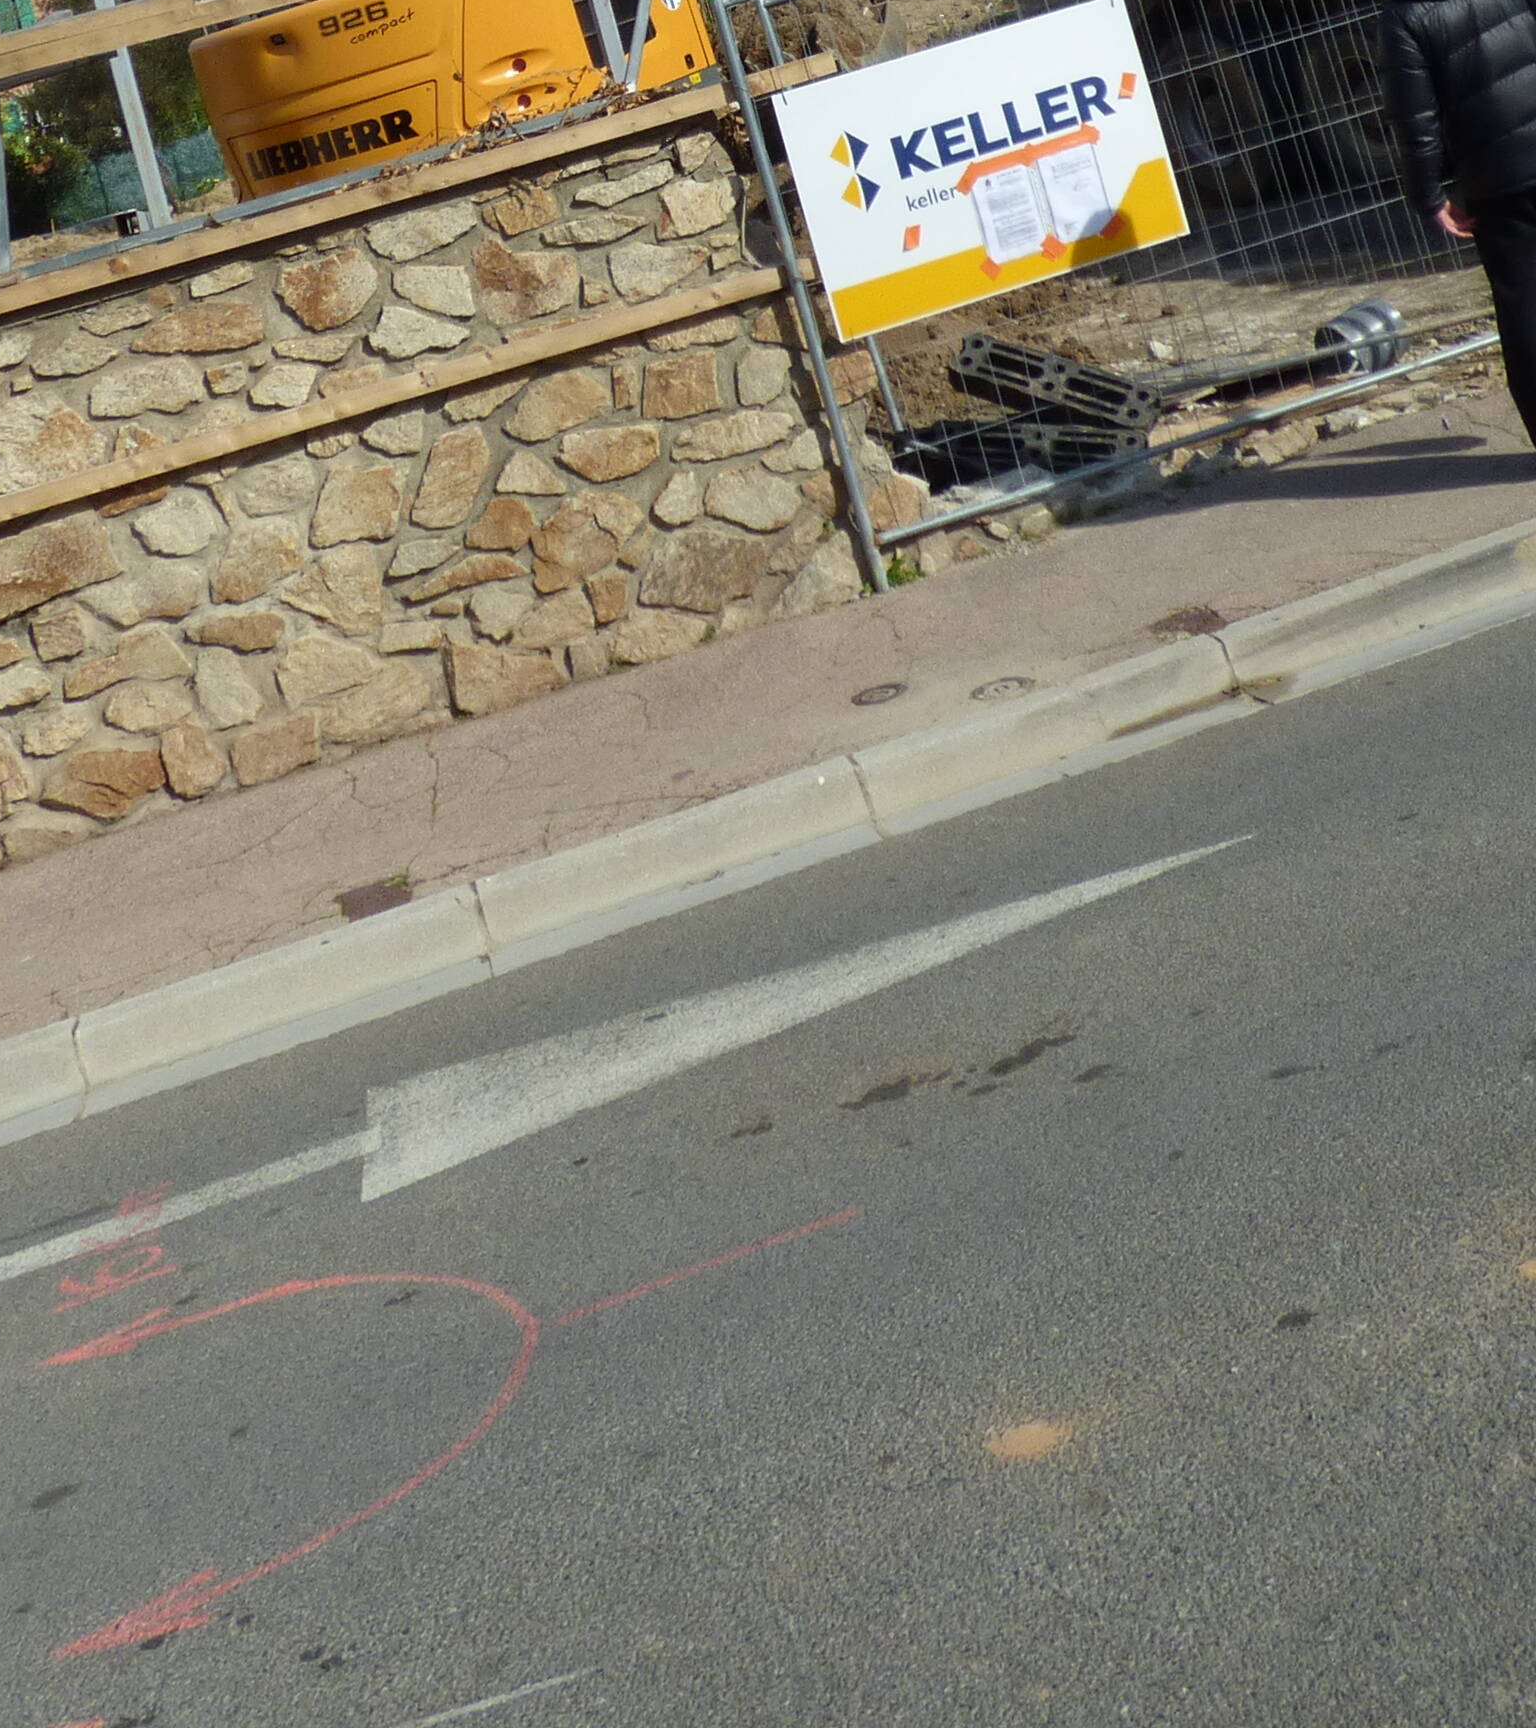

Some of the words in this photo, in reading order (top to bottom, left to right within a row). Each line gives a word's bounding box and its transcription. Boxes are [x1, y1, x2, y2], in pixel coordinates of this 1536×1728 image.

[318, 0, 390, 37] 926
[350, 8, 416, 45] compact
[246, 109, 420, 181] LIEBHERR
[889, 75, 1116, 180] KELLER
[905, 187, 958, 212] keller
